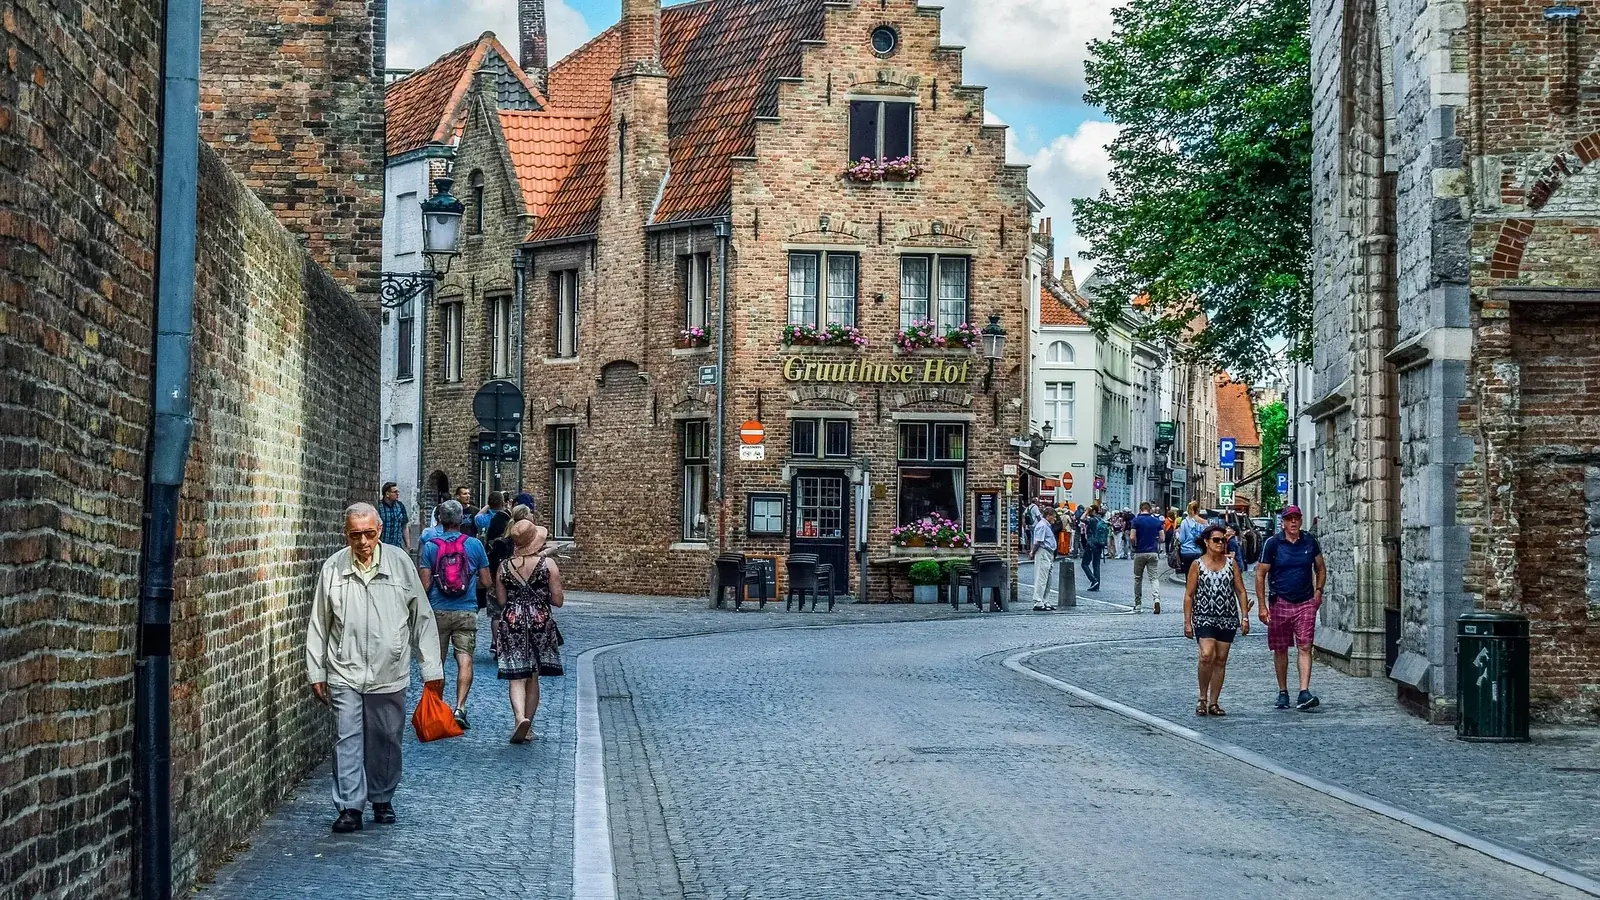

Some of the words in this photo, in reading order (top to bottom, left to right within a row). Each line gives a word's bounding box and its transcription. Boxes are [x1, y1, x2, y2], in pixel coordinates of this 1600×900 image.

[783, 355, 913, 383] Gruuthuse
[920, 357, 972, 384] Hof
[1221, 440, 1233, 457] P
[1278, 475, 1286, 486] P
